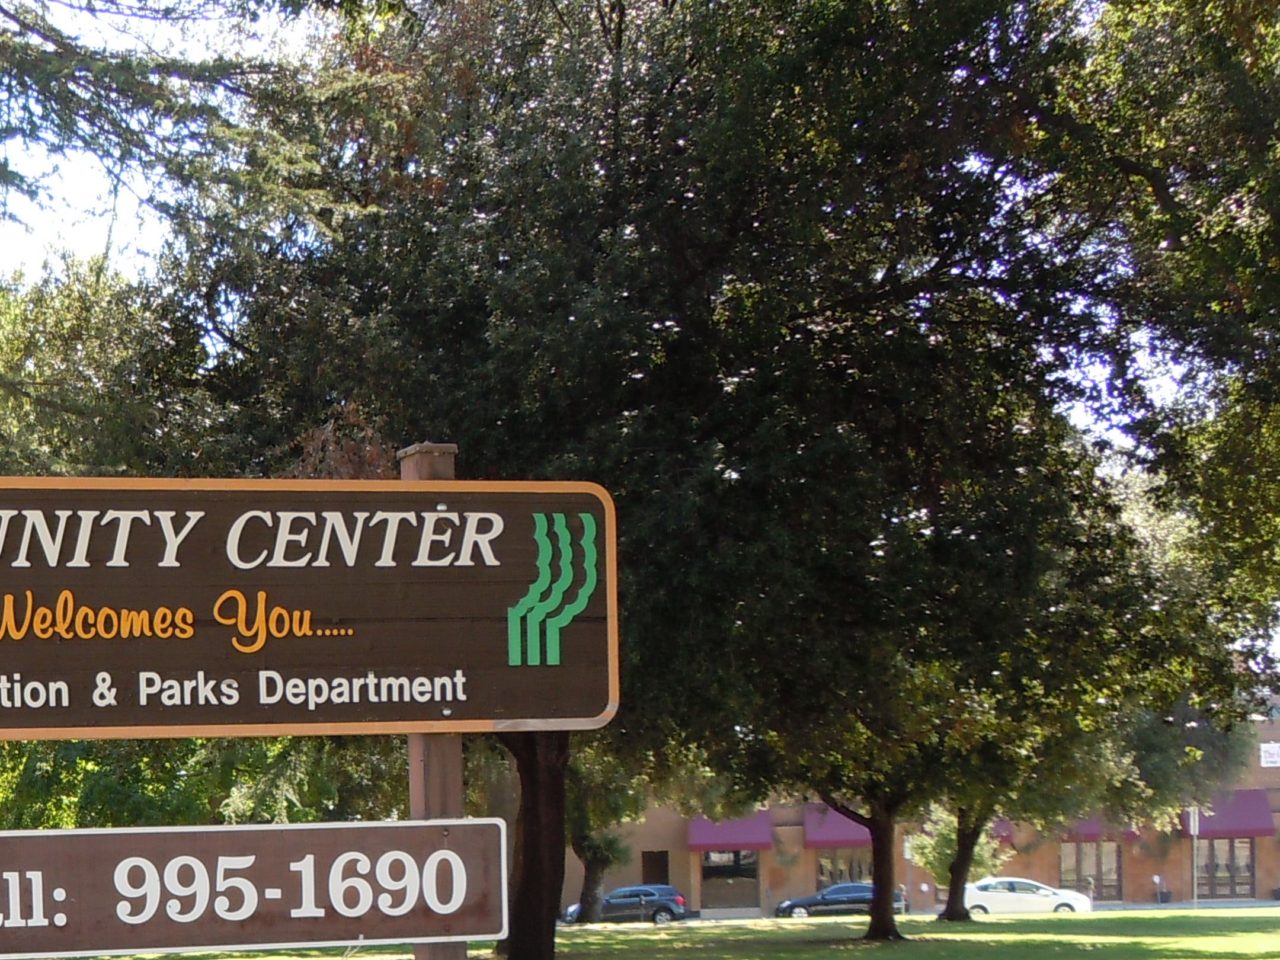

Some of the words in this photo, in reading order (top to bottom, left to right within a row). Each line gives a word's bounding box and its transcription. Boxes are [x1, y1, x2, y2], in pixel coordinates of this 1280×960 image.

[226, 511, 504, 569] CENTER
[93, 672, 117, 707] &
[139, 671, 240, 706] Parks
[259, 670, 467, 710] Department
[115, 850, 466, 924] 995-1690
